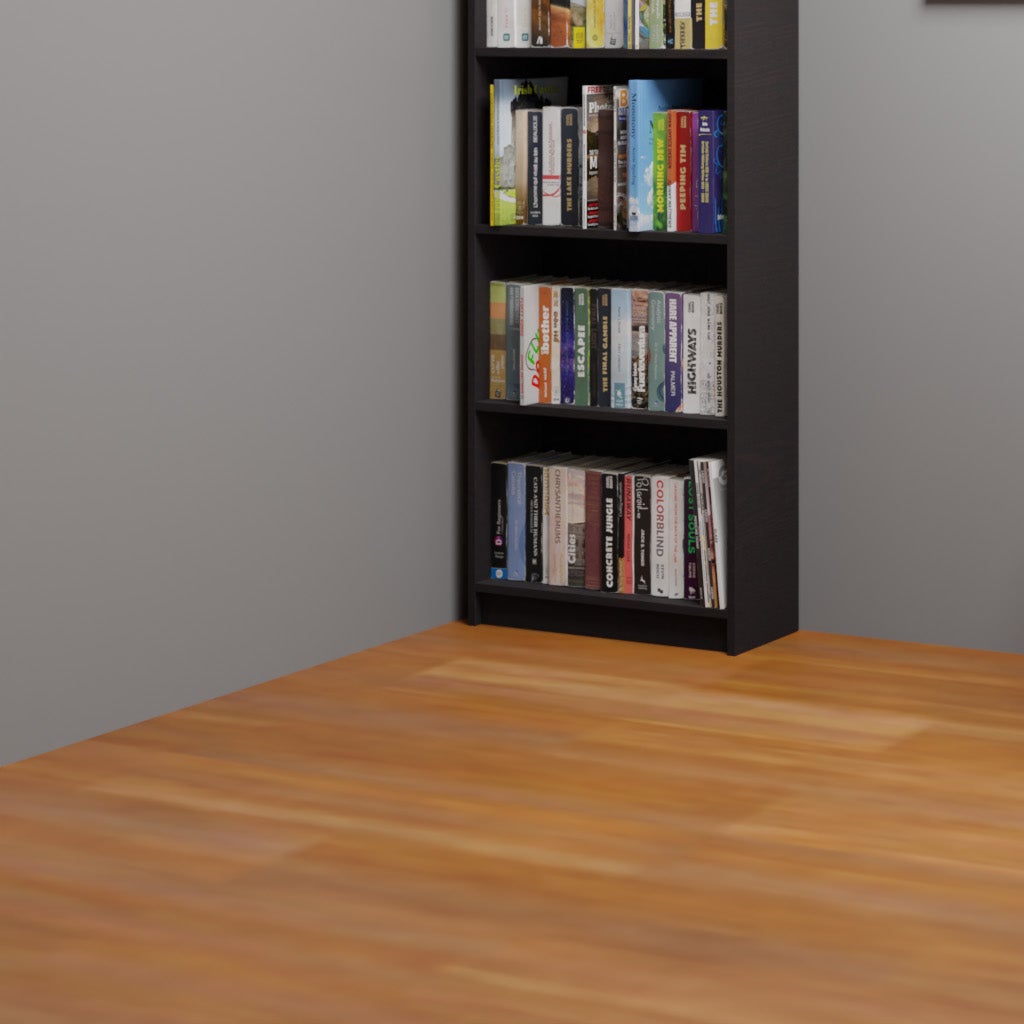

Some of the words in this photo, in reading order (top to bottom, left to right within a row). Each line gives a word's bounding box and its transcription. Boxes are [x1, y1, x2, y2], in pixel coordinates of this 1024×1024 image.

[709, 2, 718, 26] THE
[656, 137, 664, 162] DEW
[679, 144, 687, 164] TIM
[656, 163, 664, 213] MORNING
[679, 166, 687, 210] PEEPING
[669, 298, 677, 320] HARE
[577, 325, 585, 379] ESCAPEE
[601, 316, 609, 350] GAMBLE
[669, 320, 677, 364] APPARENT
[601, 352, 609, 376] FINAL
[687, 329, 697, 396] HIGHWAYS
[601, 377, 609, 393] THE
[554, 468, 562, 544] CHRYSANTHEMUMS
[605, 497, 614, 534] JUNGLE
[656, 479, 664, 557] COLORBLIND
[567, 534, 576, 564] Cities
[687, 513, 696, 555] SOULS
[605, 535, 614, 588] CONCRETE
